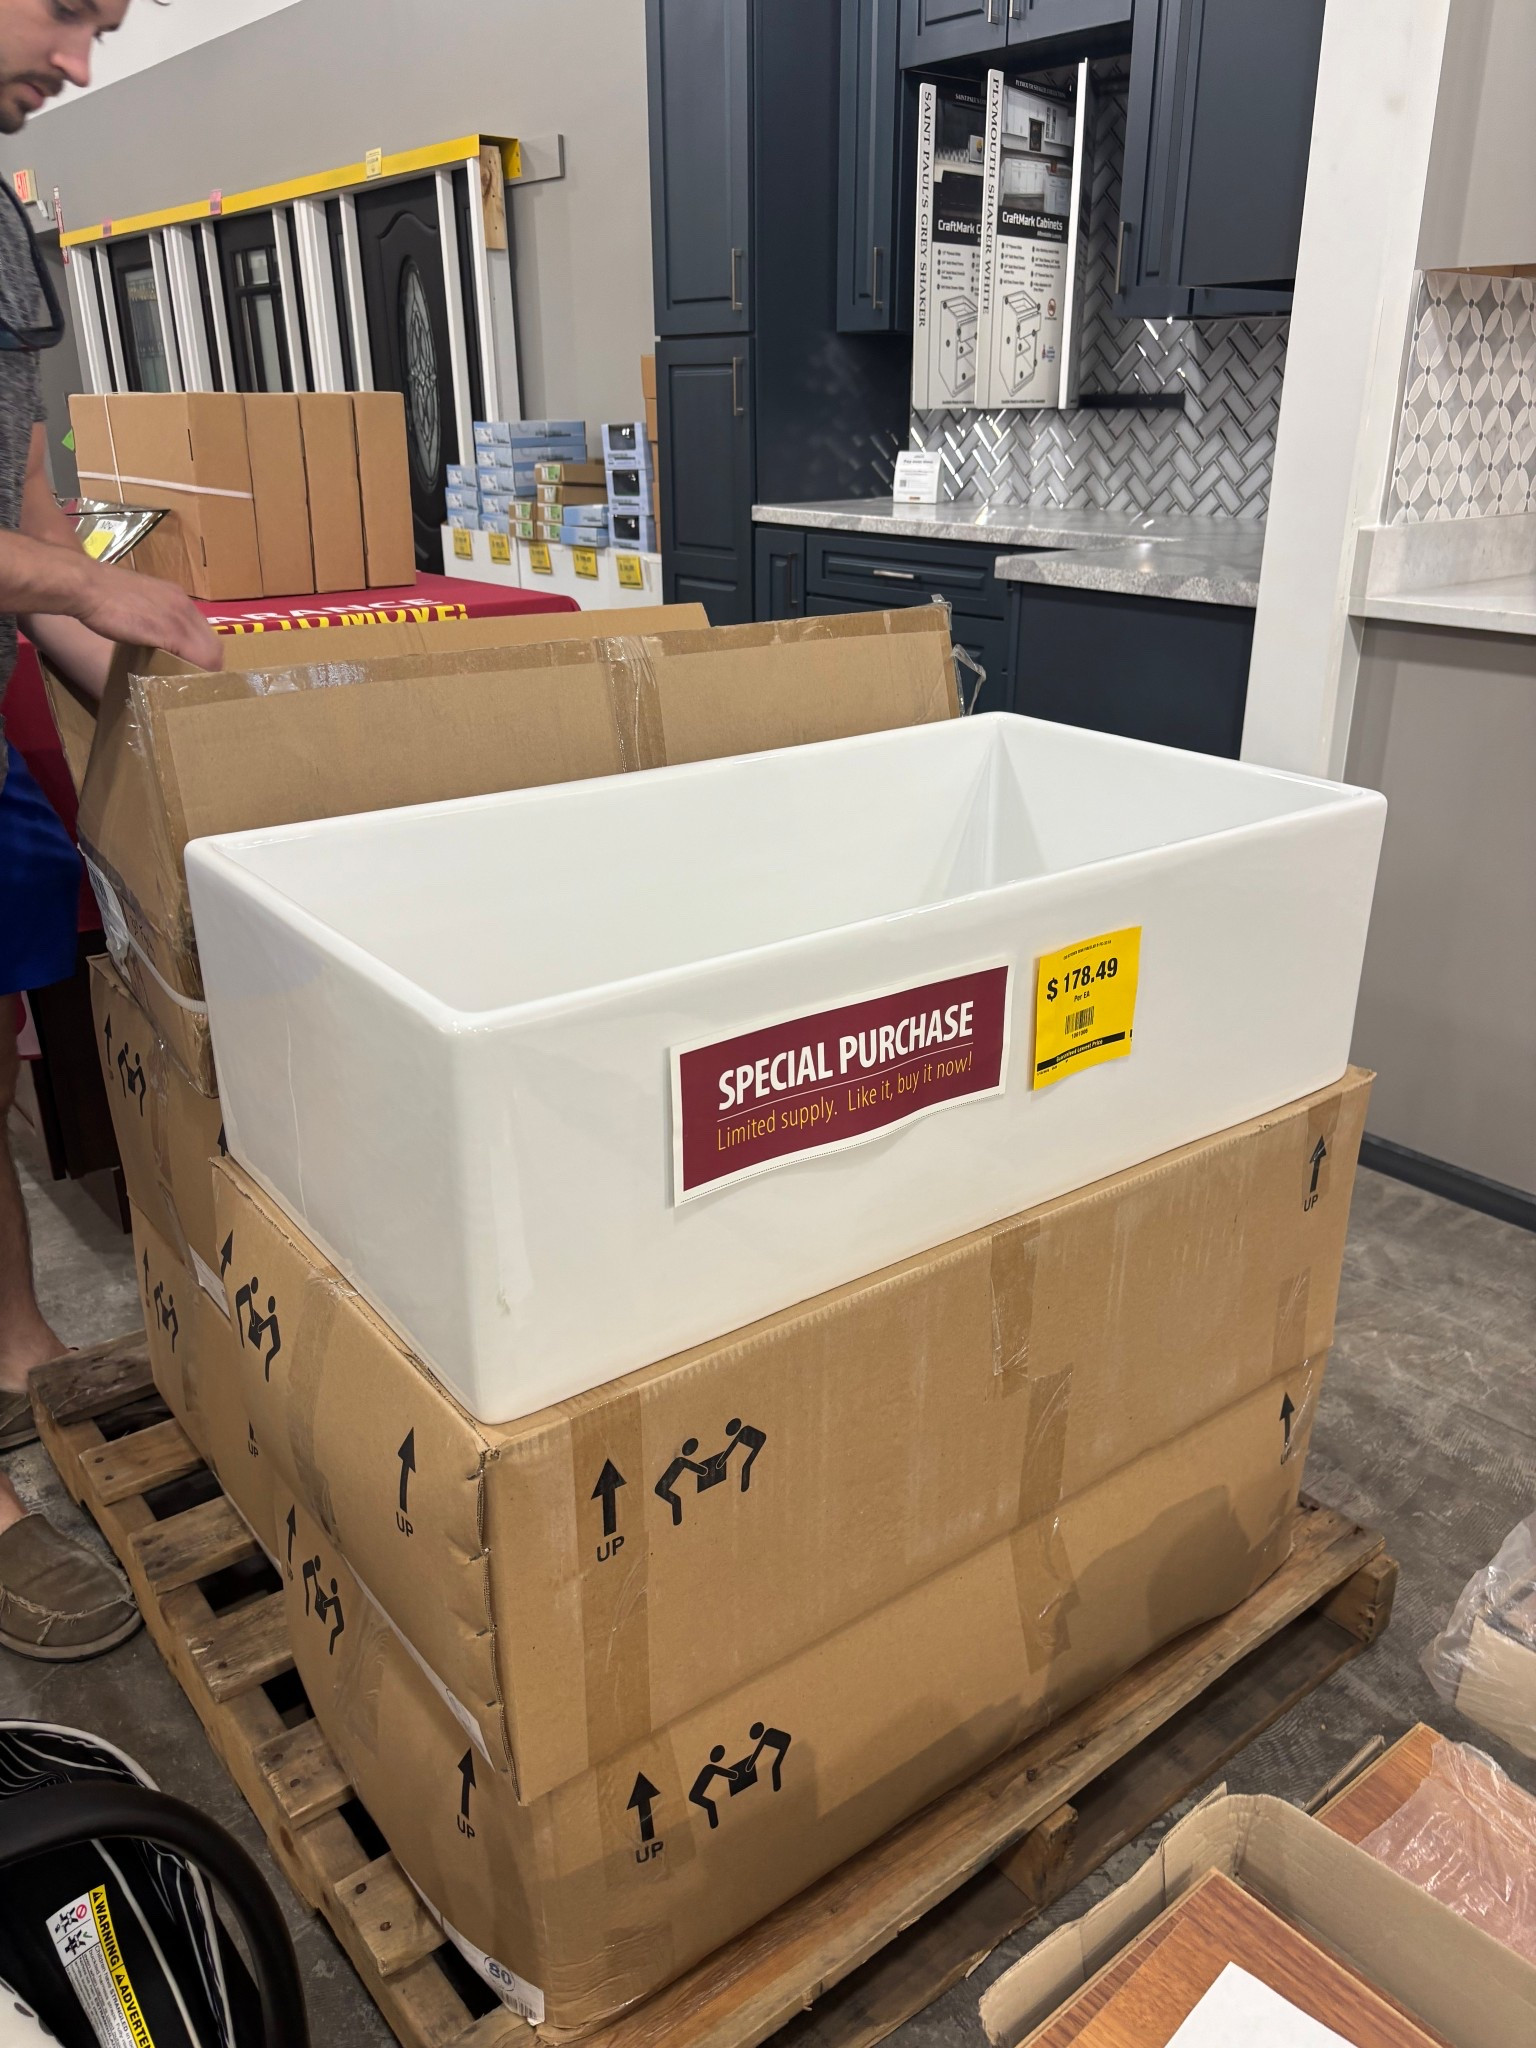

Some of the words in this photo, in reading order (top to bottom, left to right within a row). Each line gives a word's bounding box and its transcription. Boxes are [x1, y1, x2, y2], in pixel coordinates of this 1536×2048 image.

[924, 91, 932, 146] SAINT
[988, 78, 1000, 178] PLYMOUTH
[921, 150, 930, 208] PAUL'S
[938, 220, 974, 234] CraftMark
[986, 184, 996, 254] SHAKER
[1002, 212, 1036, 227] CraftMark
[1036, 216, 1063, 231] Cabinets
[920, 214, 928, 258] GREY
[919, 262, 928, 327] SHAKER
[983, 260, 992, 314] WHITE
[206, 598, 443, 625] ARANCE
[1046, 978, 1058, 1002] $
[1064, 958, 1118, 993] 178.49
[1084, 990, 1090, 998] EA
[718, 1045, 833, 1110] SPECIAL
[839, 1001, 974, 1074] PURCHASE
[1092, 1039, 1103, 1048] Price
[717, 1116, 776, 1151] Limited
[780, 1097, 838, 1134] supply.
[848, 1087, 878, 1112] Like
[880, 1078, 894, 1102] it,
[896, 1069, 920, 1094] buy
[922, 1062, 933, 1084] it
[936, 1050, 973, 1080] now!
[1304, 1194, 1319, 1213] UP
[248, 1440, 258, 1458] UP
[1280, 1447, 1292, 1466] UP
[396, 1512, 414, 1538] UP
[596, 1536, 626, 1563] UP
[456, 1814, 476, 1840] UP
[636, 1841, 664, 1864] UP
[94, 1902, 120, 1967] WARNING
[488, 1962, 512, 1986] 80
[94, 1945, 107, 1972] Children
[103, 1972, 112, 1988] have
[109, 1988, 130, 2032] STRANGLED
